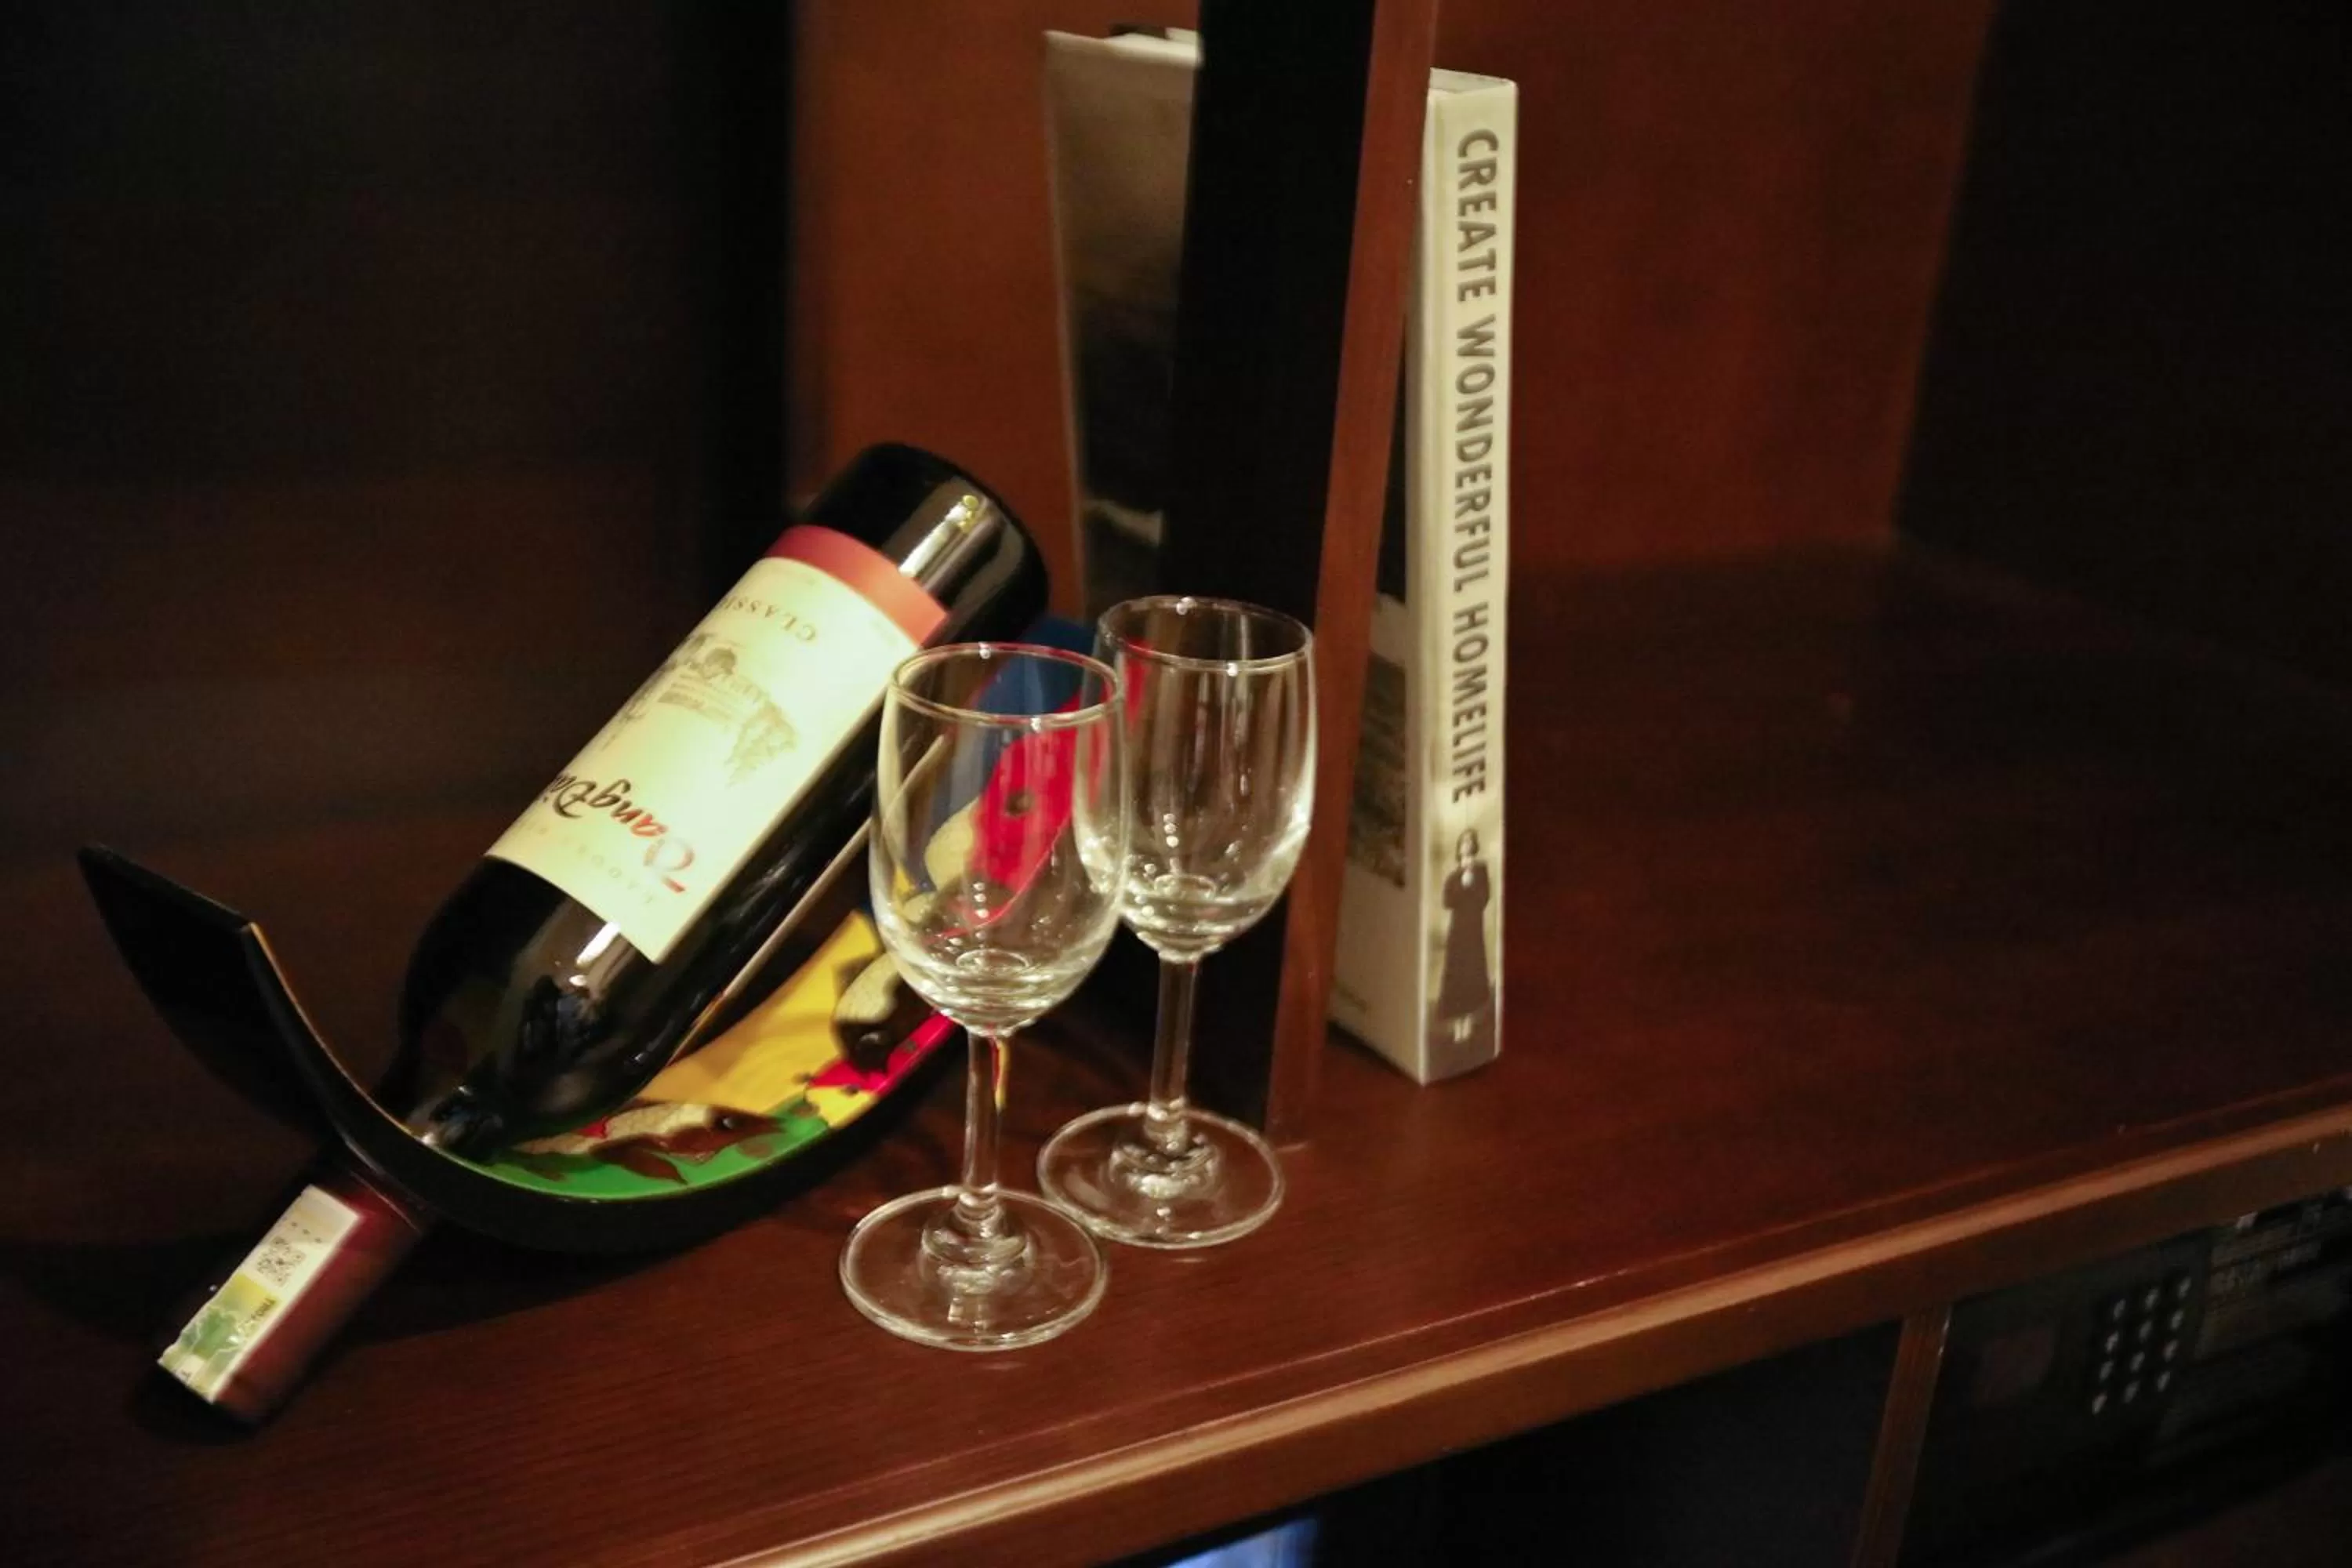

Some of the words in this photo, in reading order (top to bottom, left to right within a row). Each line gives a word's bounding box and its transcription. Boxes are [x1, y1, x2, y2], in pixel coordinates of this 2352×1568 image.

[1457, 129, 1498, 302] CREATE
[1453, 314, 1496, 593] WONDERFUL
[720, 596, 816, 641] CLASSI
[1452, 601, 1489, 804] HOMELIFE
